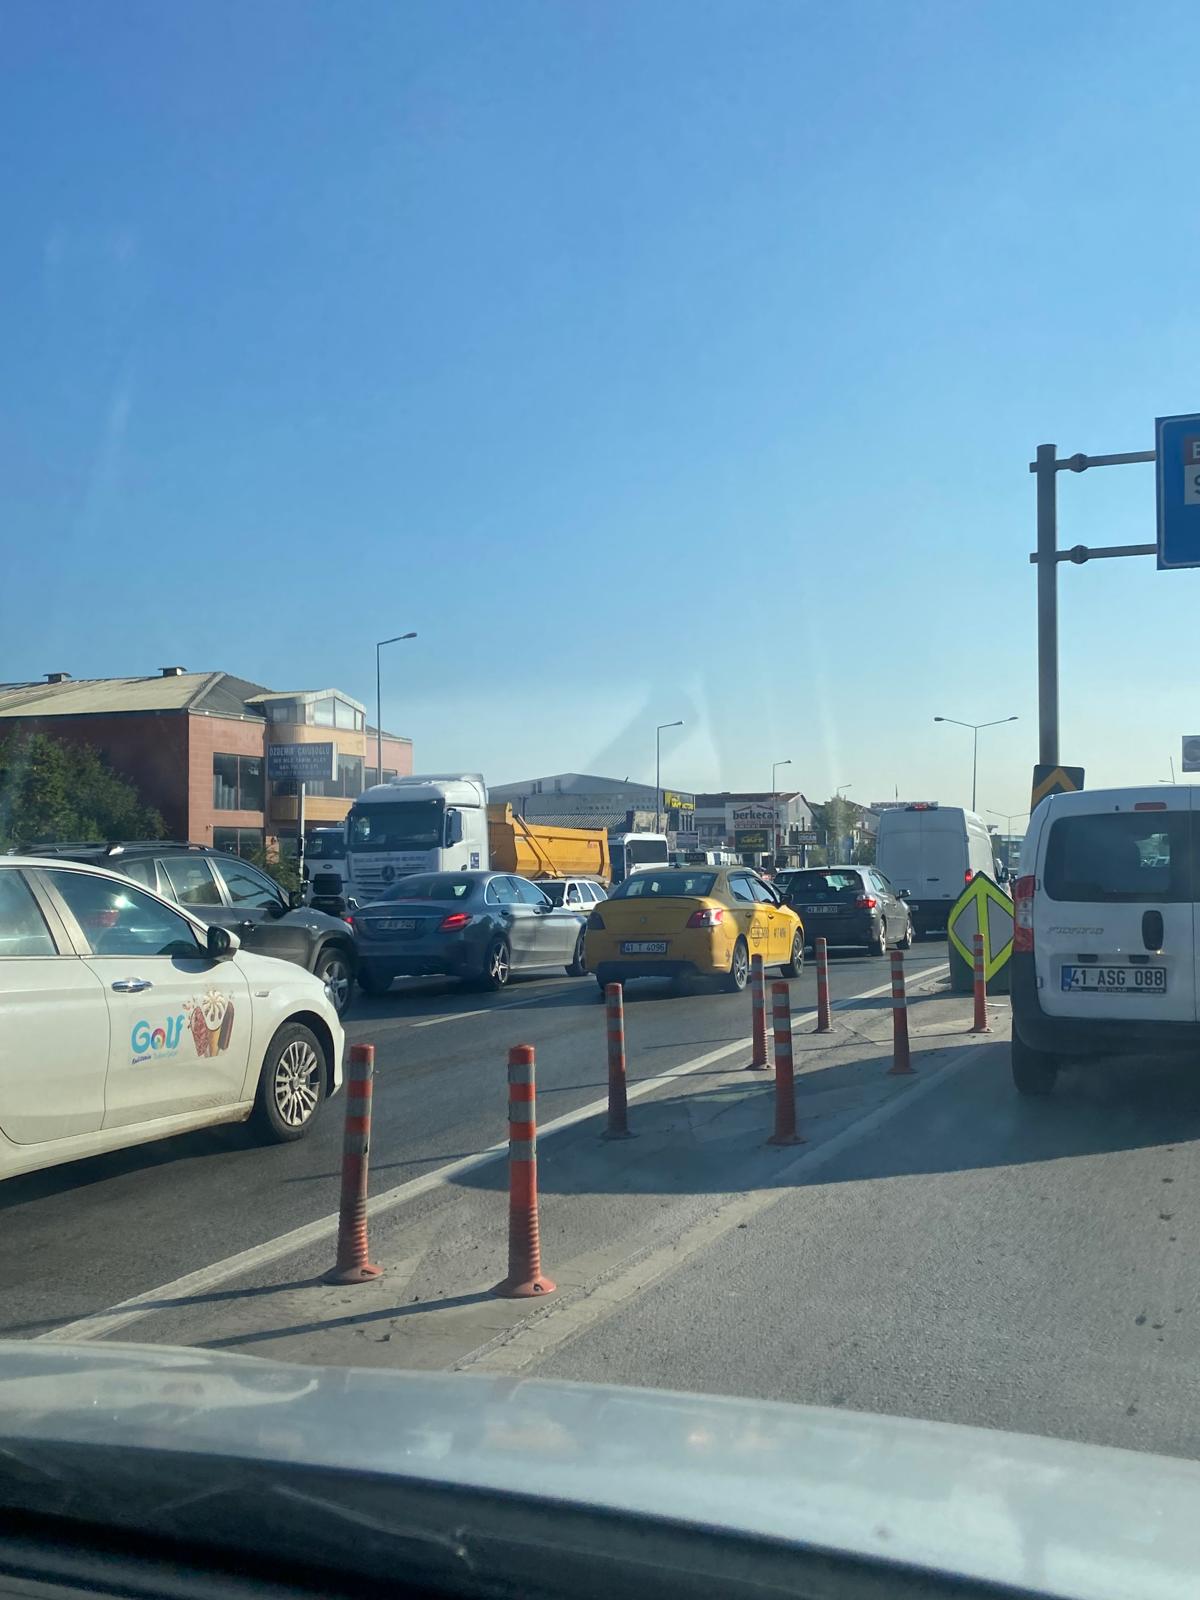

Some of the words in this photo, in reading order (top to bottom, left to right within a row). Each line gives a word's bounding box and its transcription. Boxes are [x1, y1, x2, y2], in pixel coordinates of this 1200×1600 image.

[625, 943, 634, 952] 41
[646, 943, 665, 952] 4096
[1071, 969, 1087, 986] 41
[1097, 969, 1126, 986] ASG
[1134, 970, 1164, 987] 088
[131, 1014, 185, 1054] Golf
